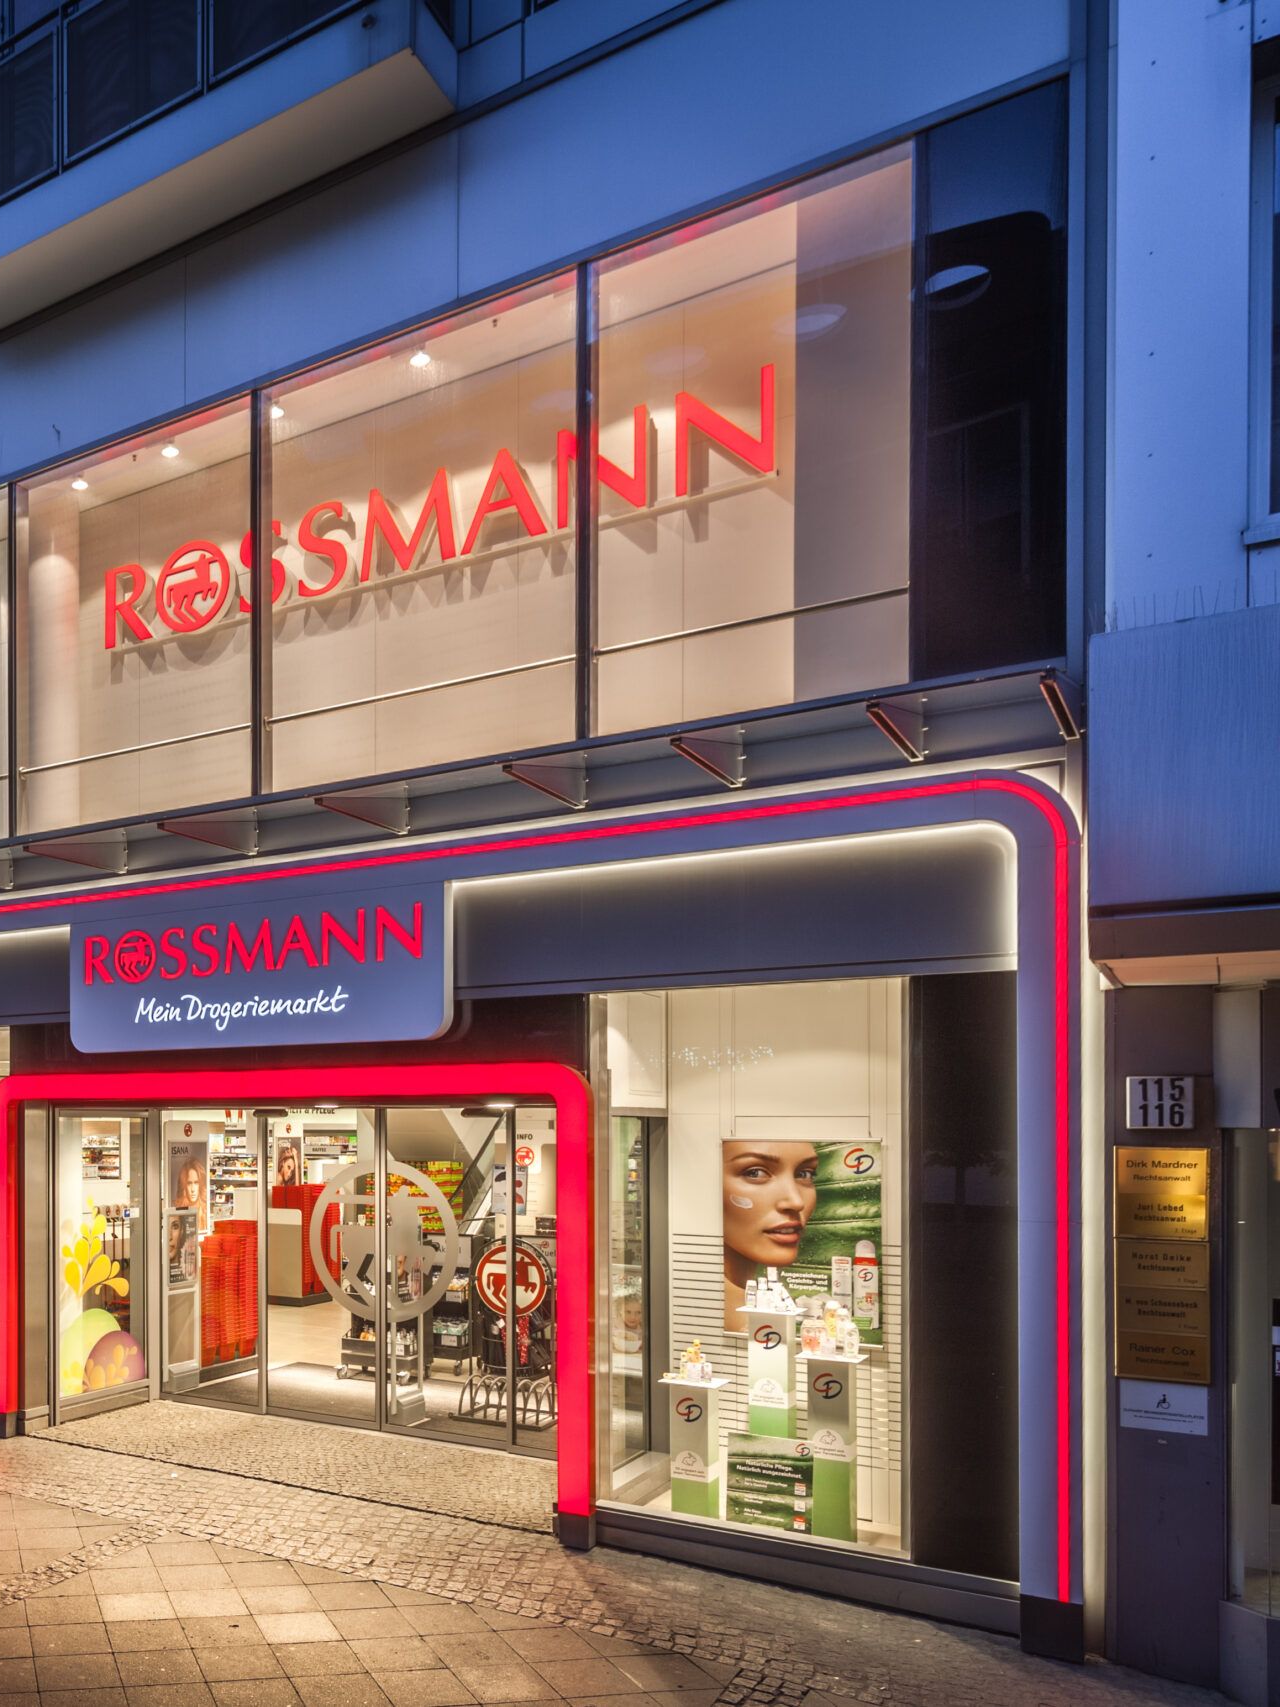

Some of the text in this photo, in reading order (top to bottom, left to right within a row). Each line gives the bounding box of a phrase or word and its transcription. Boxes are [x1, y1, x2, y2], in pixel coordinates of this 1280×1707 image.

[104, 364, 775, 649] ROSSMANN
[84, 902, 423, 985] ROSSMANN
[134, 985, 348, 1031] Mein Drogeriemarkt
[1138, 1078, 1185, 1102] 115
[1139, 1103, 1184, 1126] 116
[171, 1146, 188, 1154] ISANA
[1126, 1160, 1147, 1168] Dirk
[1134, 1214, 1186, 1222] Rechtsanwalt
[1137, 1263, 1185, 1272] Rechtsanwalt
[781, 1271, 827, 1279] Ausgezeichnete
[789, 1283, 828, 1291] Körperpflege
[1138, 1308, 1185, 1318] Rechtsanwalt
[1129, 1343, 1196, 1356] Rainer Cox
